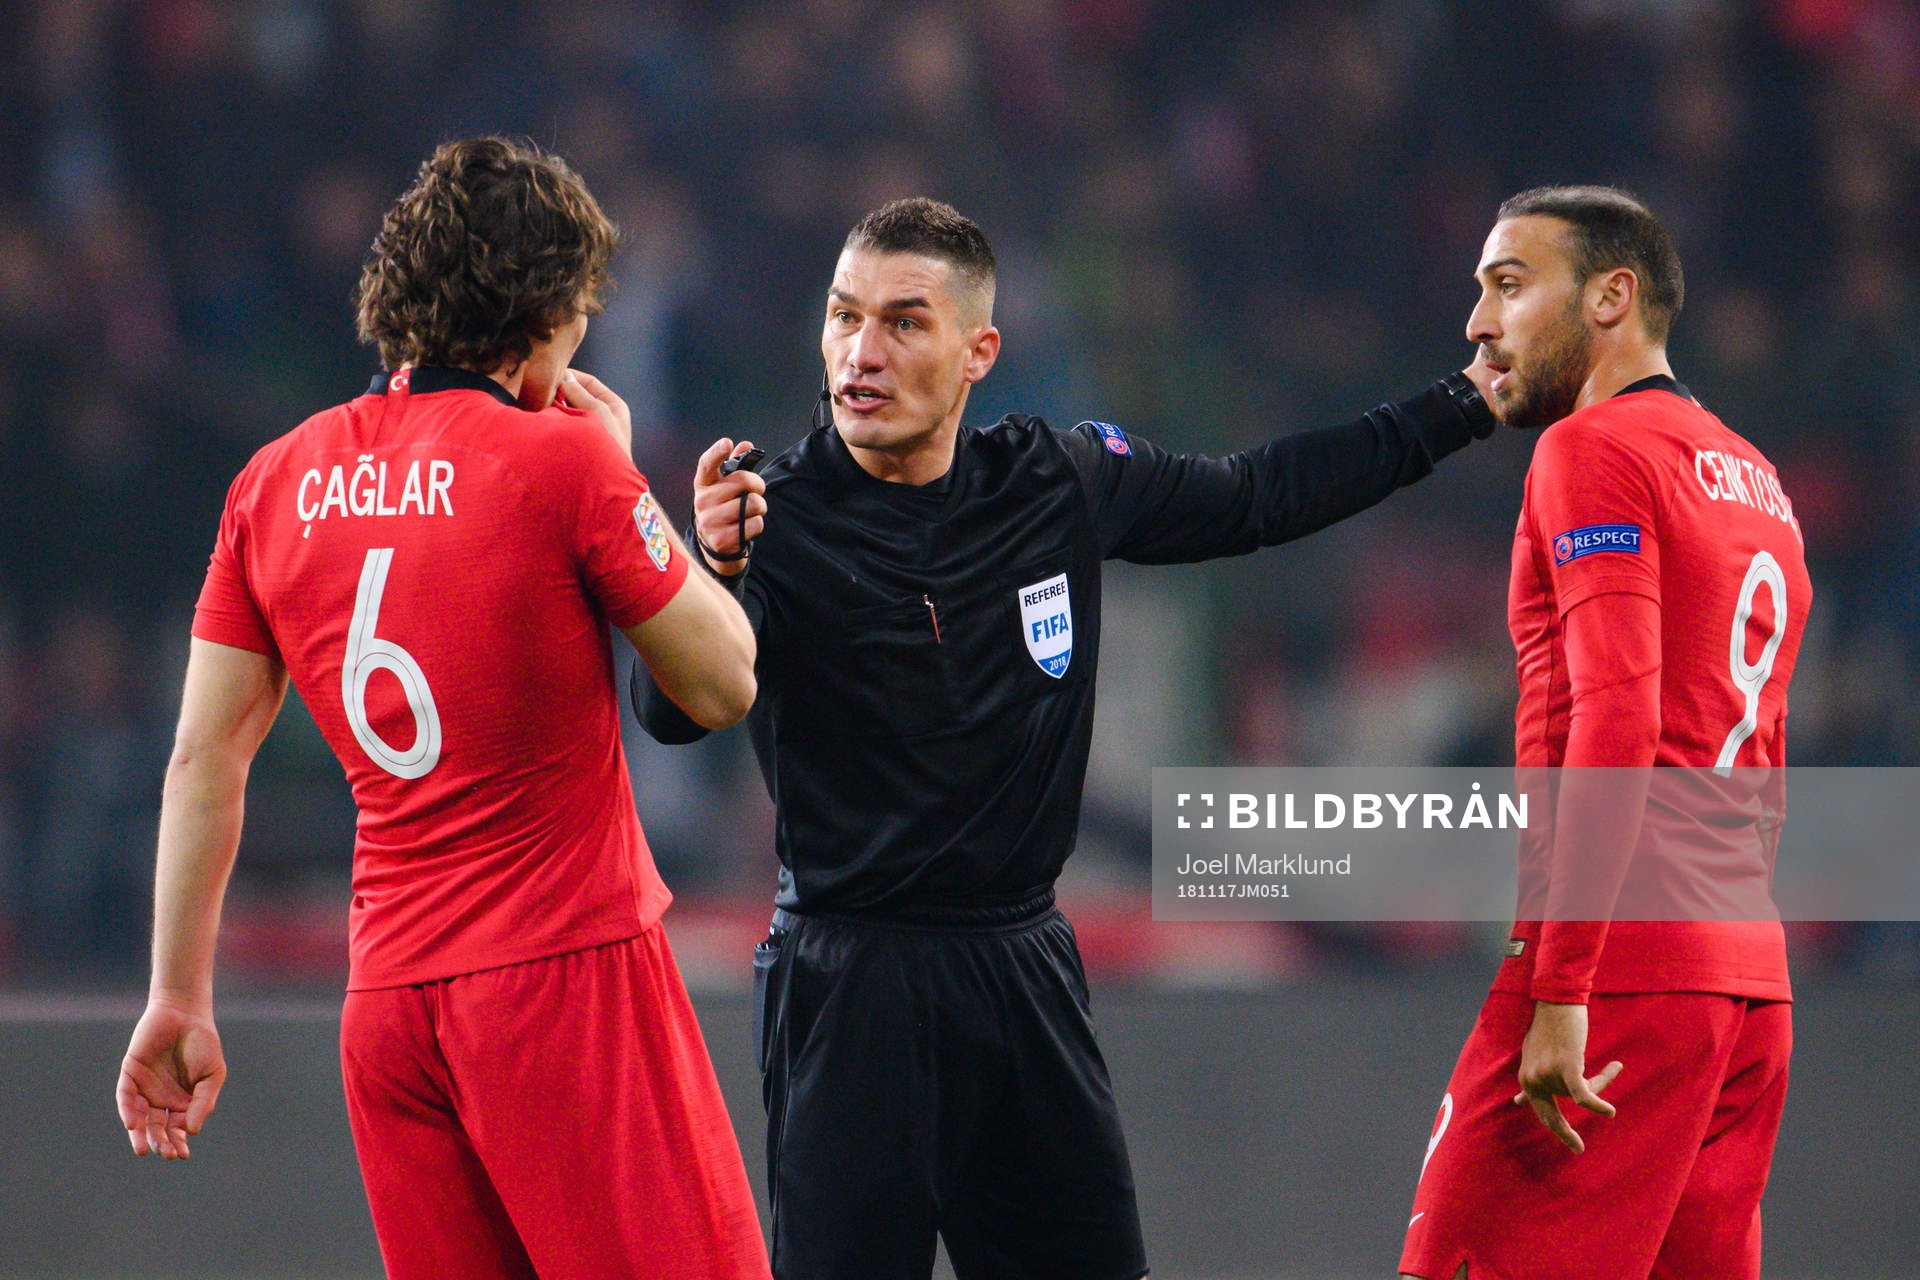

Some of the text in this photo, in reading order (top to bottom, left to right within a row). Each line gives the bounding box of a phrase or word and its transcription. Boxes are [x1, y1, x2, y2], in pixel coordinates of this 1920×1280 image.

[1695, 450, 1803, 544] CENKTOS
[1574, 531, 1640, 550] RESPECT
[1024, 581, 1066, 607] REFEREE
[1031, 612, 1069, 643] FIFA
[341, 548, 442, 780] 6
[1049, 656, 1067, 671] 2018
[1712, 550, 1787, 779] 9
